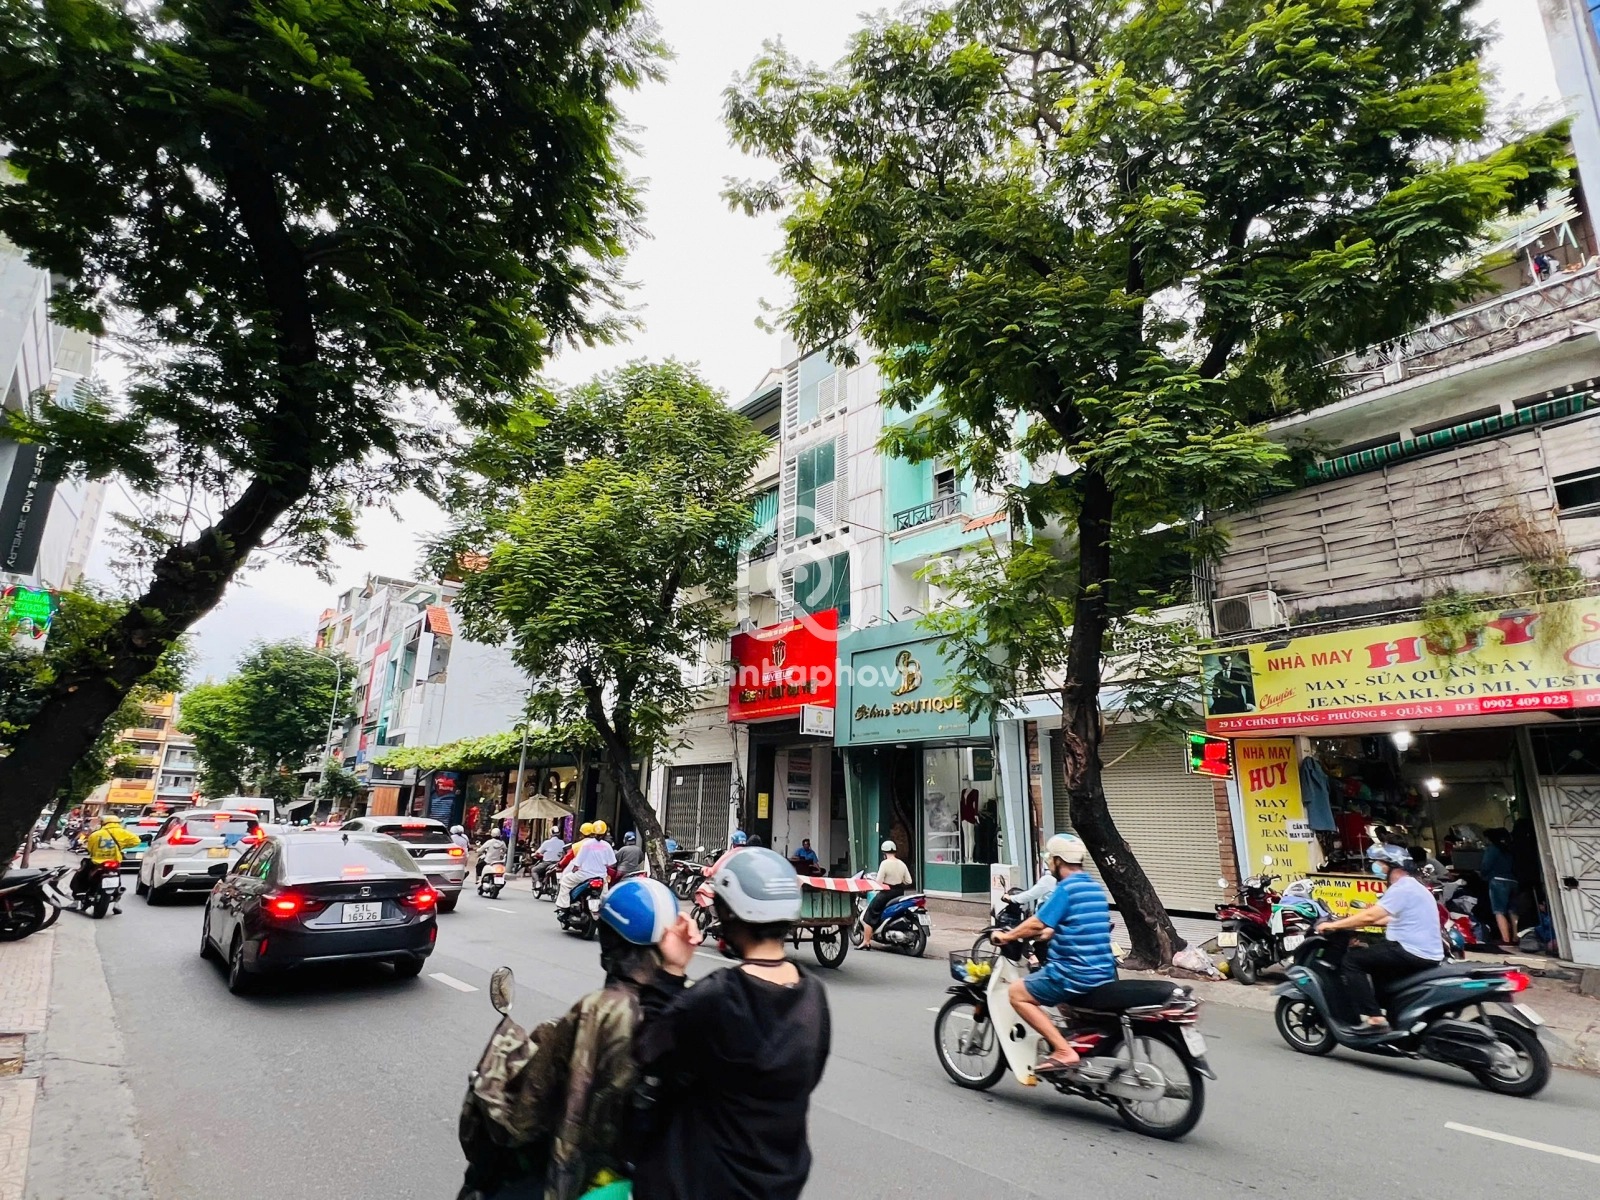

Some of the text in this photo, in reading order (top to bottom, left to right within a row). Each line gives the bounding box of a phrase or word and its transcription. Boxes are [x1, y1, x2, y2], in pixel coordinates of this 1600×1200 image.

[7, 445, 47, 568] CFFE AND JEWELRY
[1267, 612, 1544, 671] NHÀ MAY HUY
[1305, 678, 1348, 692] MAY
[1365, 671, 1406, 687] SỬA
[1412, 663, 1477, 683] QUẦN
[1487, 659, 1533, 675] TÂY
[1307, 693, 1373, 709] JEANS,
[1378, 687, 1440, 702] KAKI,
[1445, 682, 1475, 697] SƠ
[1482, 681, 1520, 694] MI,
[891, 695, 964, 716] BOUTIQUE
[1230, 719, 1244, 728] LÝ
[1245, 717, 1279, 727] CHÍNH
[1280, 713, 1319, 725] THẮNG
[1328, 706, 1377, 720] PHƯỜNG
[1380, 709, 1388, 717] 8
[1396, 706, 1433, 717] QUẬN
[1436, 705, 1443, 713] 3
[1455, 702, 1479, 712] ĐT:
[1483, 698, 1514, 709] 0902
[1516, 696, 1540, 706] 409
[1543, 694, 1569, 705] 028
[1243, 744, 1291, 759] NHÀ MAY
[1248, 762, 1288, 792] HUY
[1255, 799, 1288, 808] MAY
[1258, 811, 1287, 823] SỬA
[1266, 843, 1289, 852] KAKI
[1105, 855, 1116, 866] 15
[1334, 880, 1352, 888] MAY
[1356, 880, 1388, 893] HU
[354, 904, 371, 912] 51L
